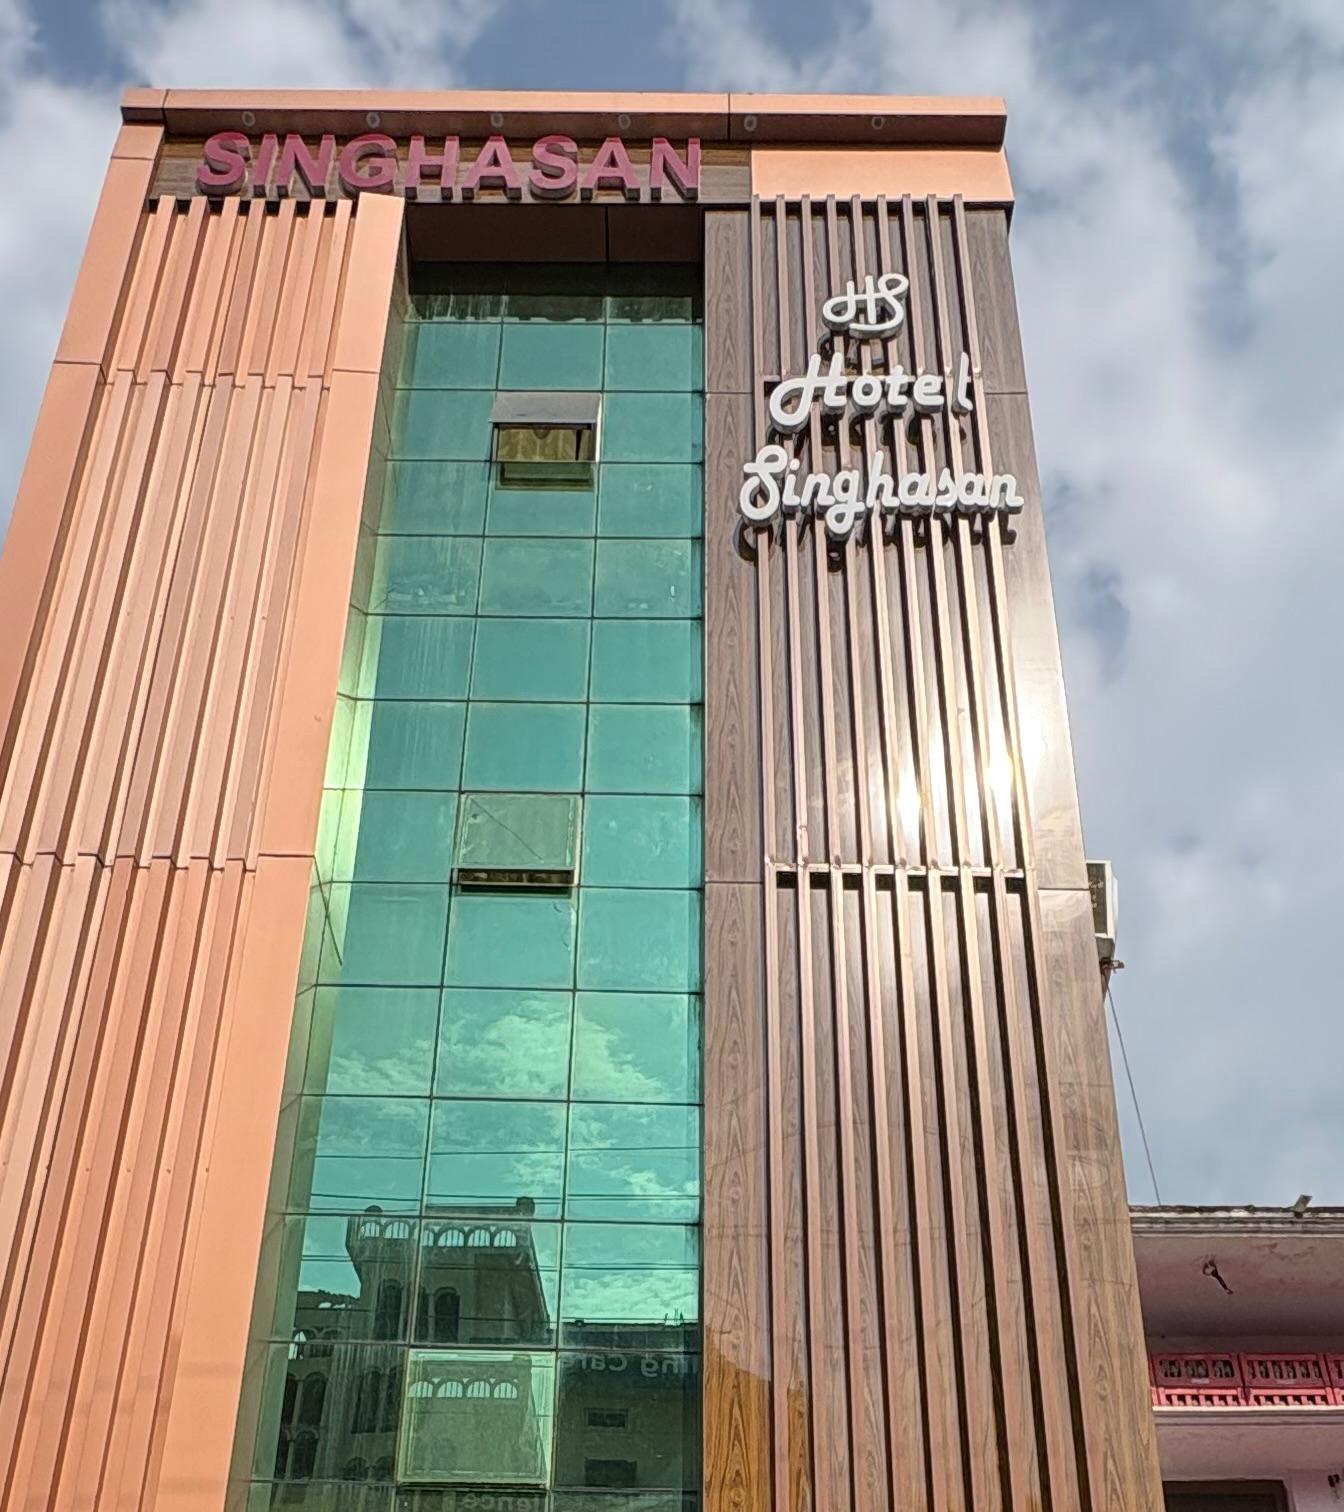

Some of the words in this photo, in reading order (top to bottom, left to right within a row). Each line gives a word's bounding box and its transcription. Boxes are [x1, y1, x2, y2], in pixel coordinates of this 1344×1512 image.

[196, 131, 702, 198] SINGHASAN
[769, 352, 974, 434] Hotel
[739, 445, 1025, 540] Singhasan
